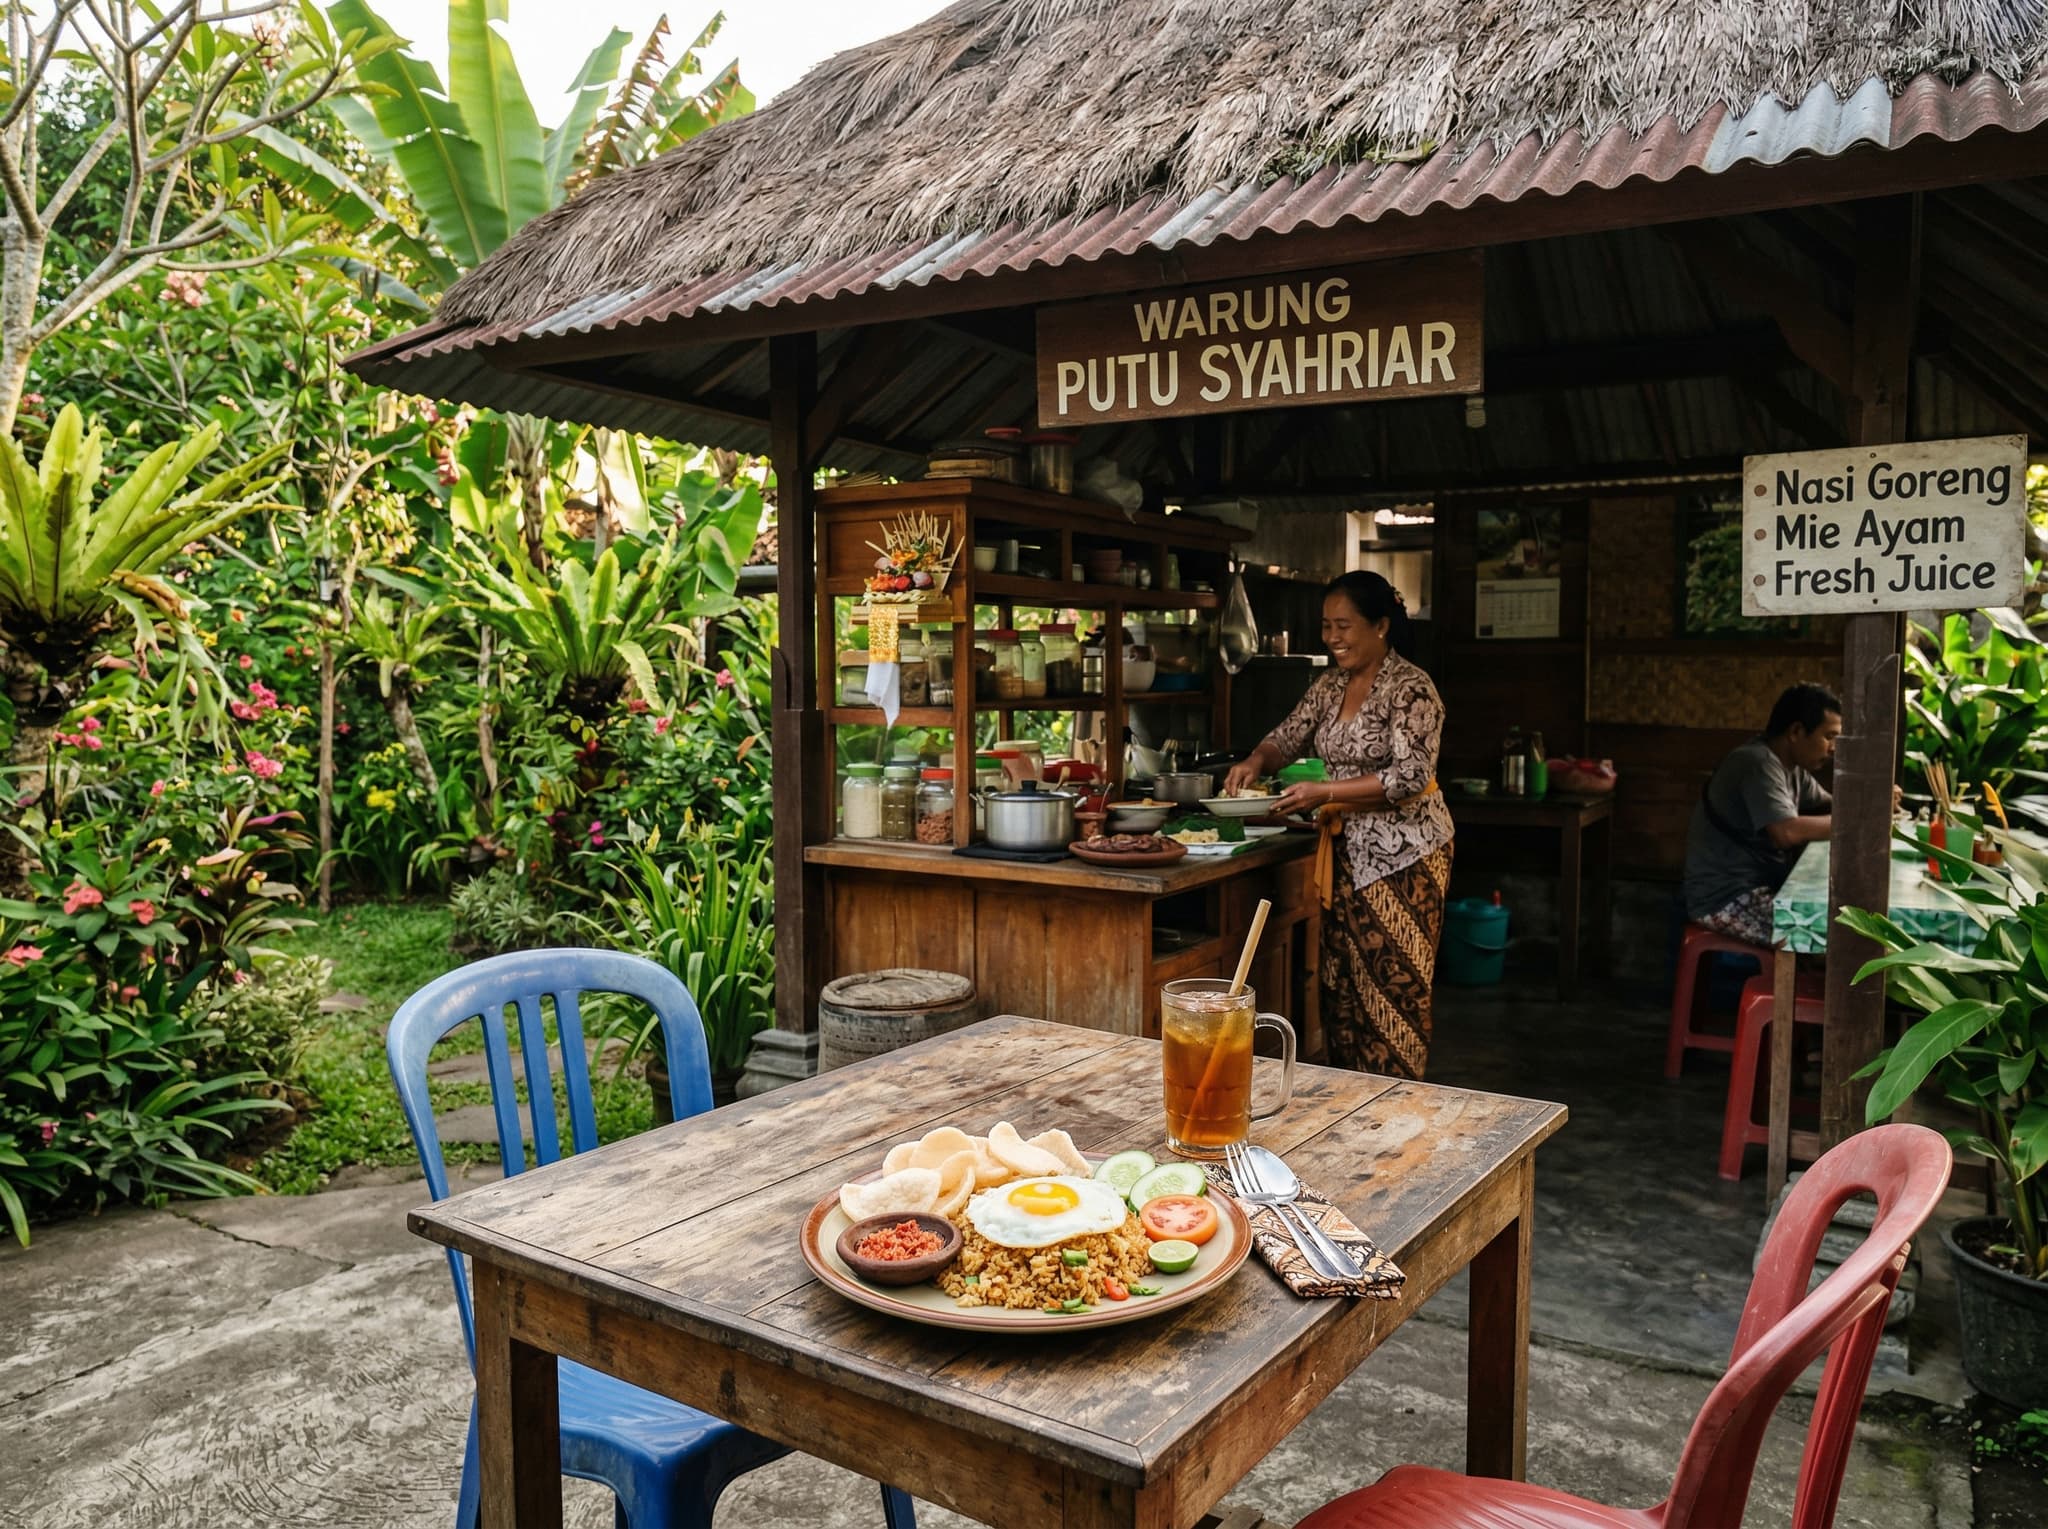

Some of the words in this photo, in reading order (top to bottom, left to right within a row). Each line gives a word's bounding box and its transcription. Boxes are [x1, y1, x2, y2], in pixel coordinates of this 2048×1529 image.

[1134, 277, 1351, 342] WARUNG
[1057, 350, 1179, 415] PUTU
[1199, 321, 1456, 402] SYAHRIAR
[1776, 465, 1854, 506] Nasi
[1868, 462, 2011, 505] Goreng
[1776, 513, 1840, 551] Mie
[1854, 509, 1965, 557] Ayam
[1775, 557, 1875, 596] Fresh
[1888, 554, 1996, 592] Juice
